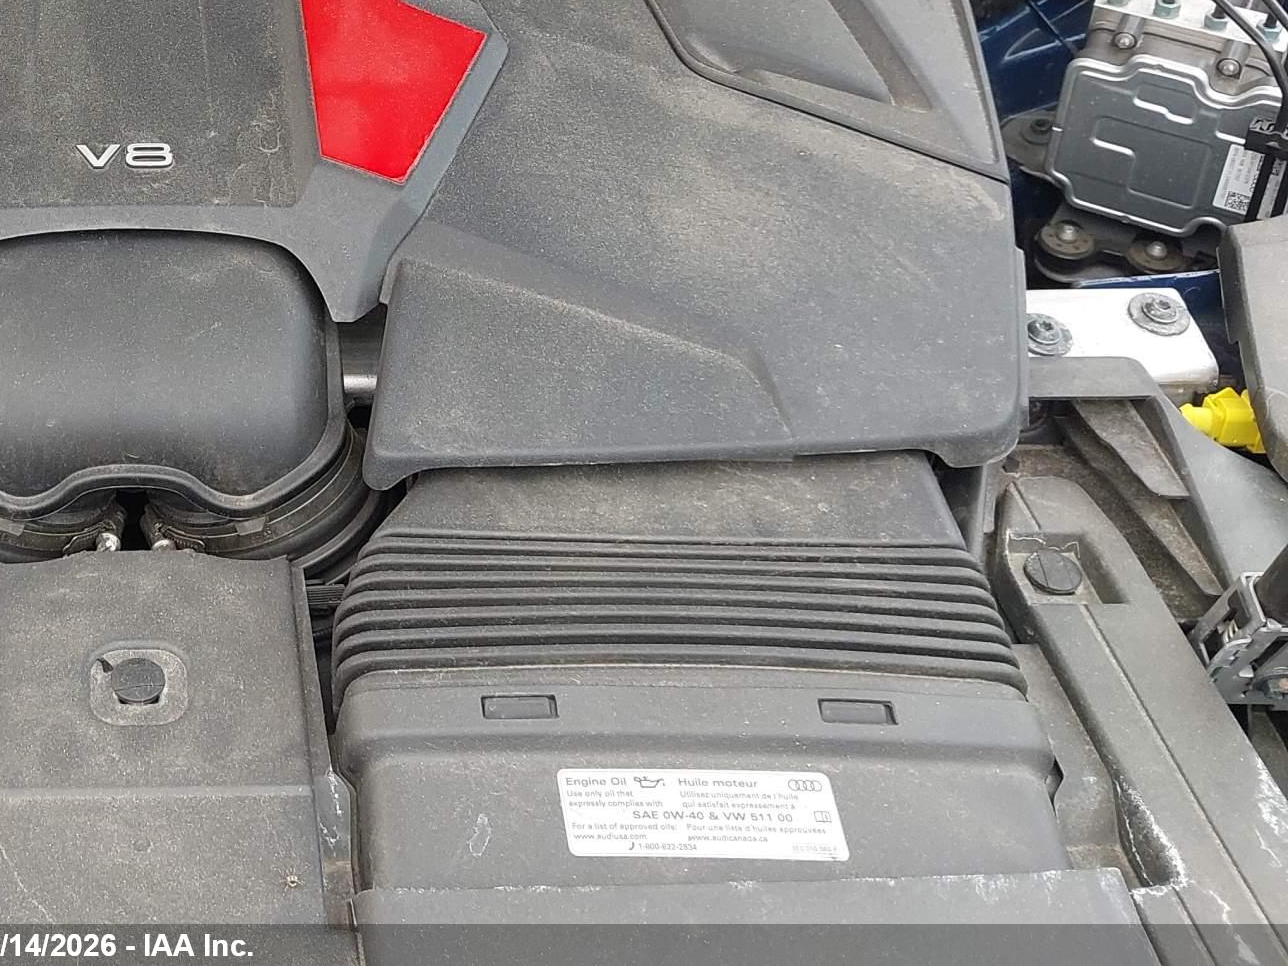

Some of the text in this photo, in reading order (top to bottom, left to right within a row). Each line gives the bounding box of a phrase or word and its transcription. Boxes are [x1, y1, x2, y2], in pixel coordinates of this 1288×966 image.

[74, 142, 173, 169] V8
[565, 777, 627, 787] Engine Oil
[678, 777, 758, 788] Huile moteur
[585, 790, 602, 798] only
[711, 792, 759, 800] uniquement
[569, 800, 606, 808] expressly
[607, 800, 644, 808] complies
[632, 810, 793, 823] SAE 0W-40 & VW 511 00
[572, 822, 585, 830] For
[594, 822, 608, 830] list
[609, 822, 618, 830] of
[619, 822, 658, 831] approved
[686, 823, 707, 831] Pour
[725, 824, 743, 832] liste
